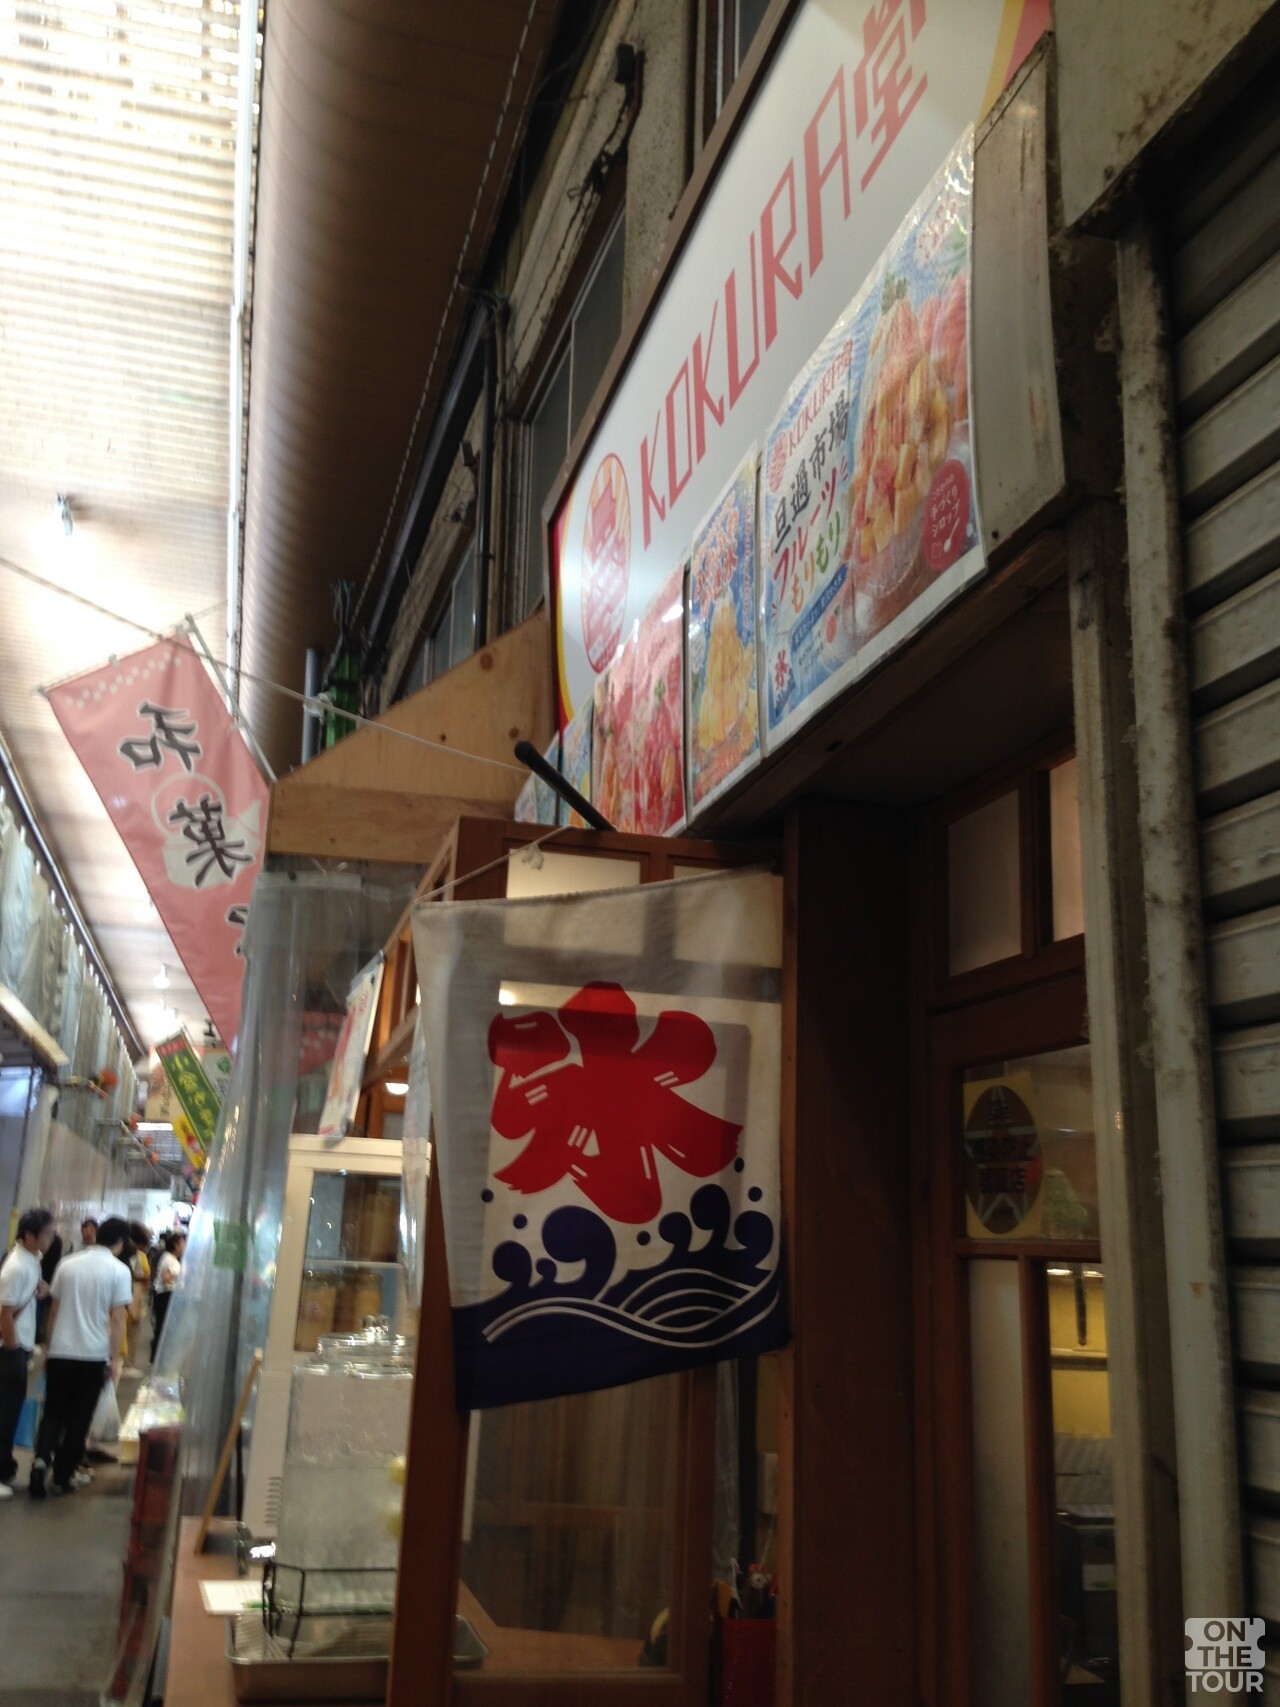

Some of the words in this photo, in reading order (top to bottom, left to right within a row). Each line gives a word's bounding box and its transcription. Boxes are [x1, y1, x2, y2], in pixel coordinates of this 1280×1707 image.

[773, 467, 837, 602] フルーツ
[774, 389, 850, 553] 旦過市場
[791, 511, 841, 613] もりもり
[488, 981, 744, 1224] 氷
